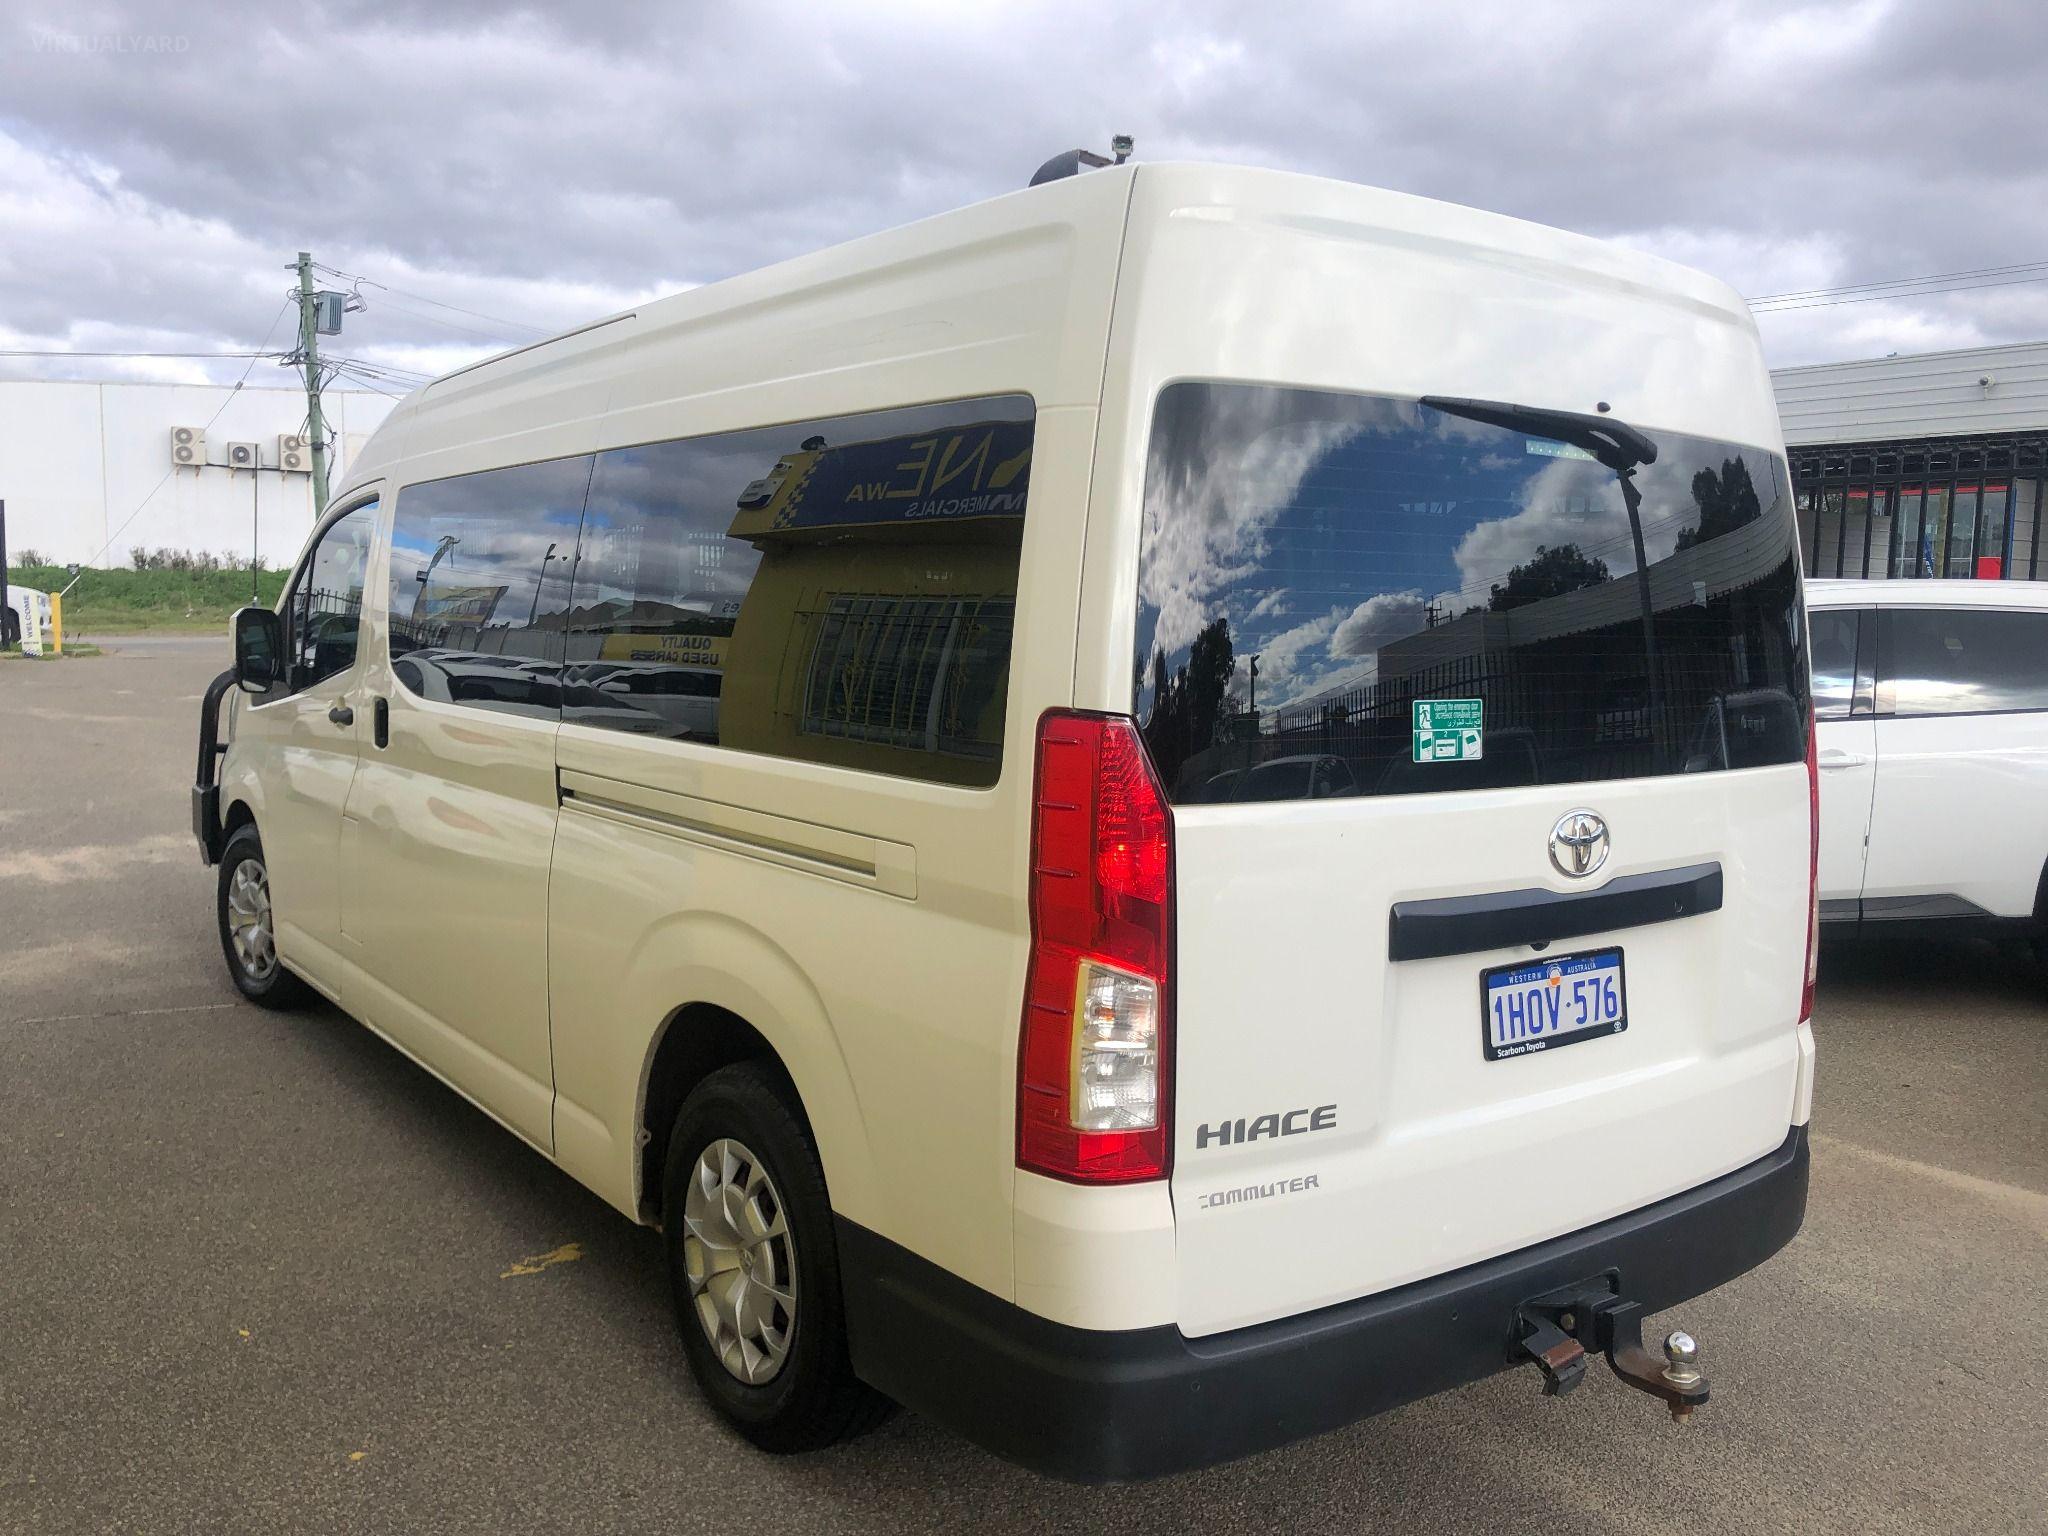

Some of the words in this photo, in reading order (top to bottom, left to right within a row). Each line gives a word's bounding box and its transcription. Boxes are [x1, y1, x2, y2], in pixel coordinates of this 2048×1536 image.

[23, 595, 33, 638] WELCOME
[1509, 972, 1541, 984] WESTERN
[1567, 962, 1597, 974] AUSTRALIA
[1497, 1046, 1526, 1058] Scarboro
[1526, 1041, 1546, 1052] Toyota
[1196, 1104, 1337, 1149] HIACE
